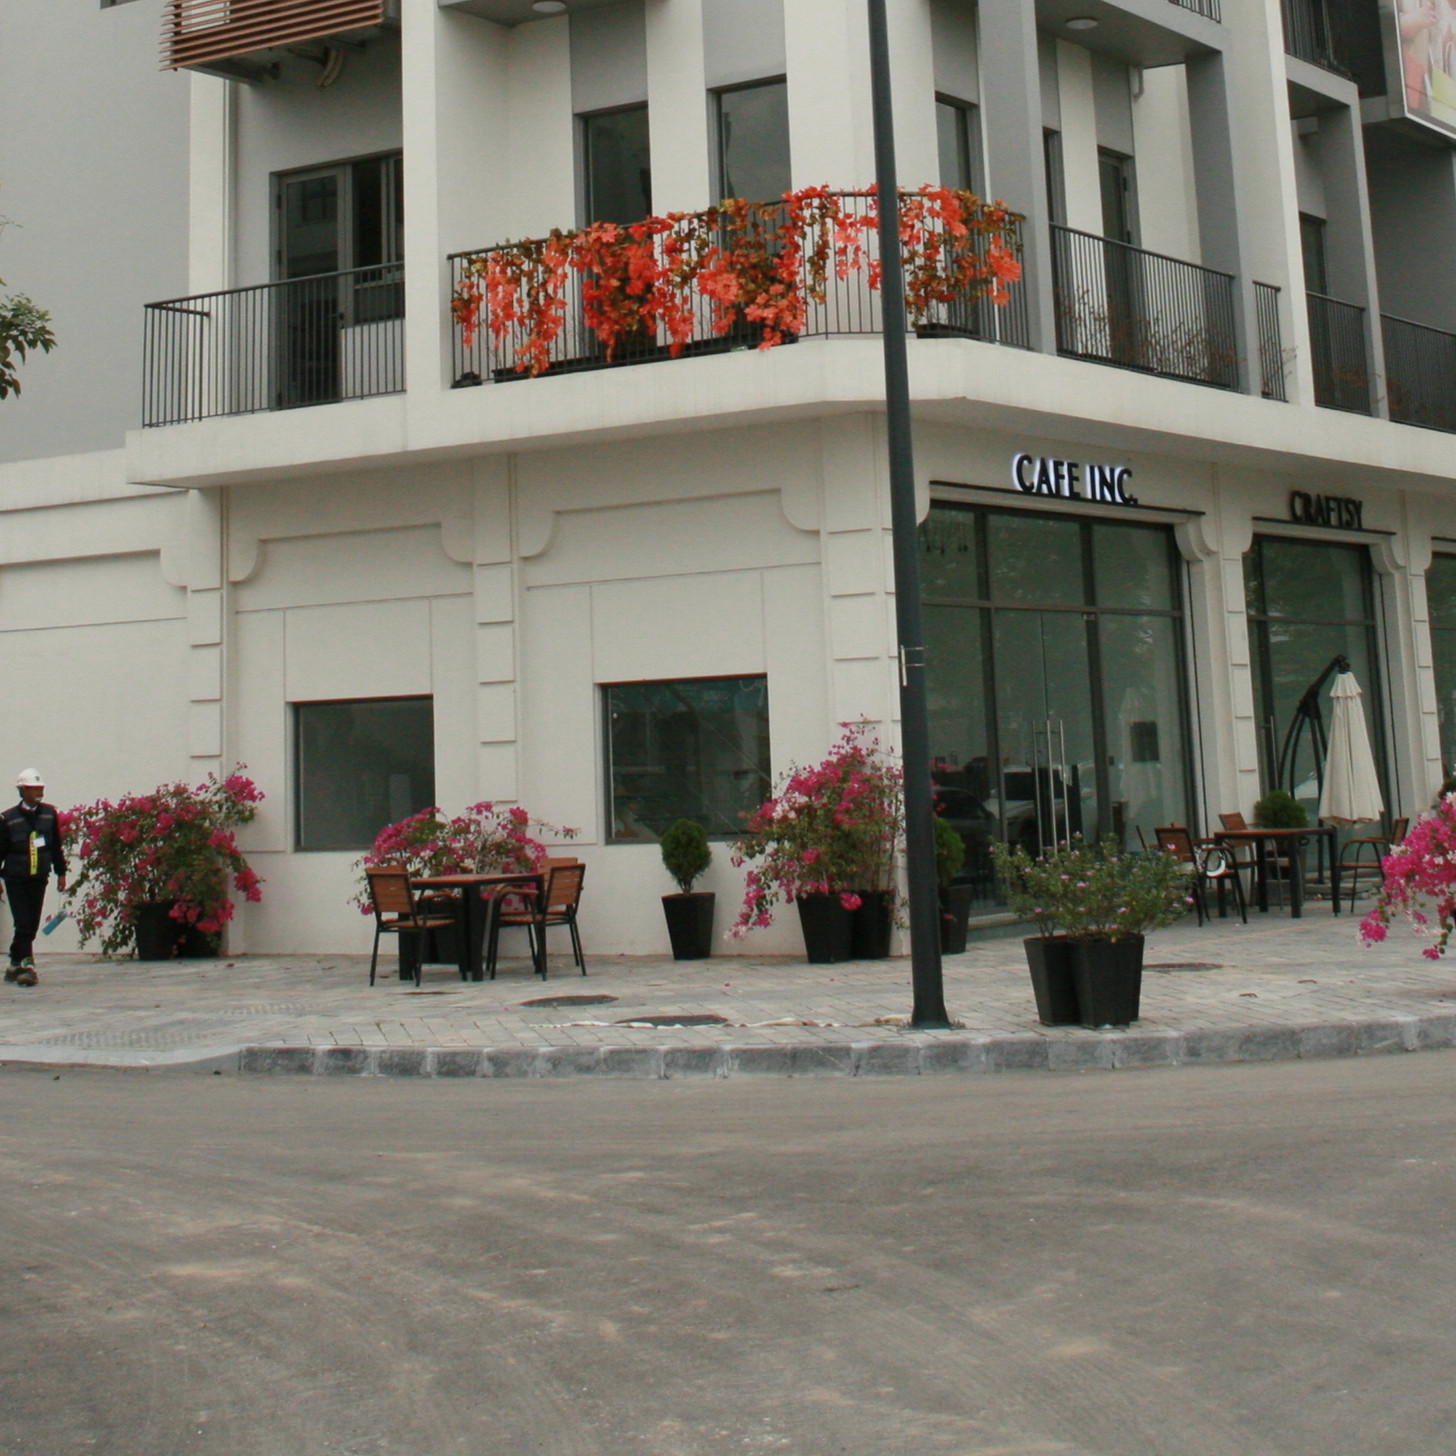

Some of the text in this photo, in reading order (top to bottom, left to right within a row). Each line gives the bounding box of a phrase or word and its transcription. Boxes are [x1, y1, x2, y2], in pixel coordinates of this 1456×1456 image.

[1014, 453, 1139, 505] CAFE INC.
[1290, 490, 1364, 531] CRAFTSY
